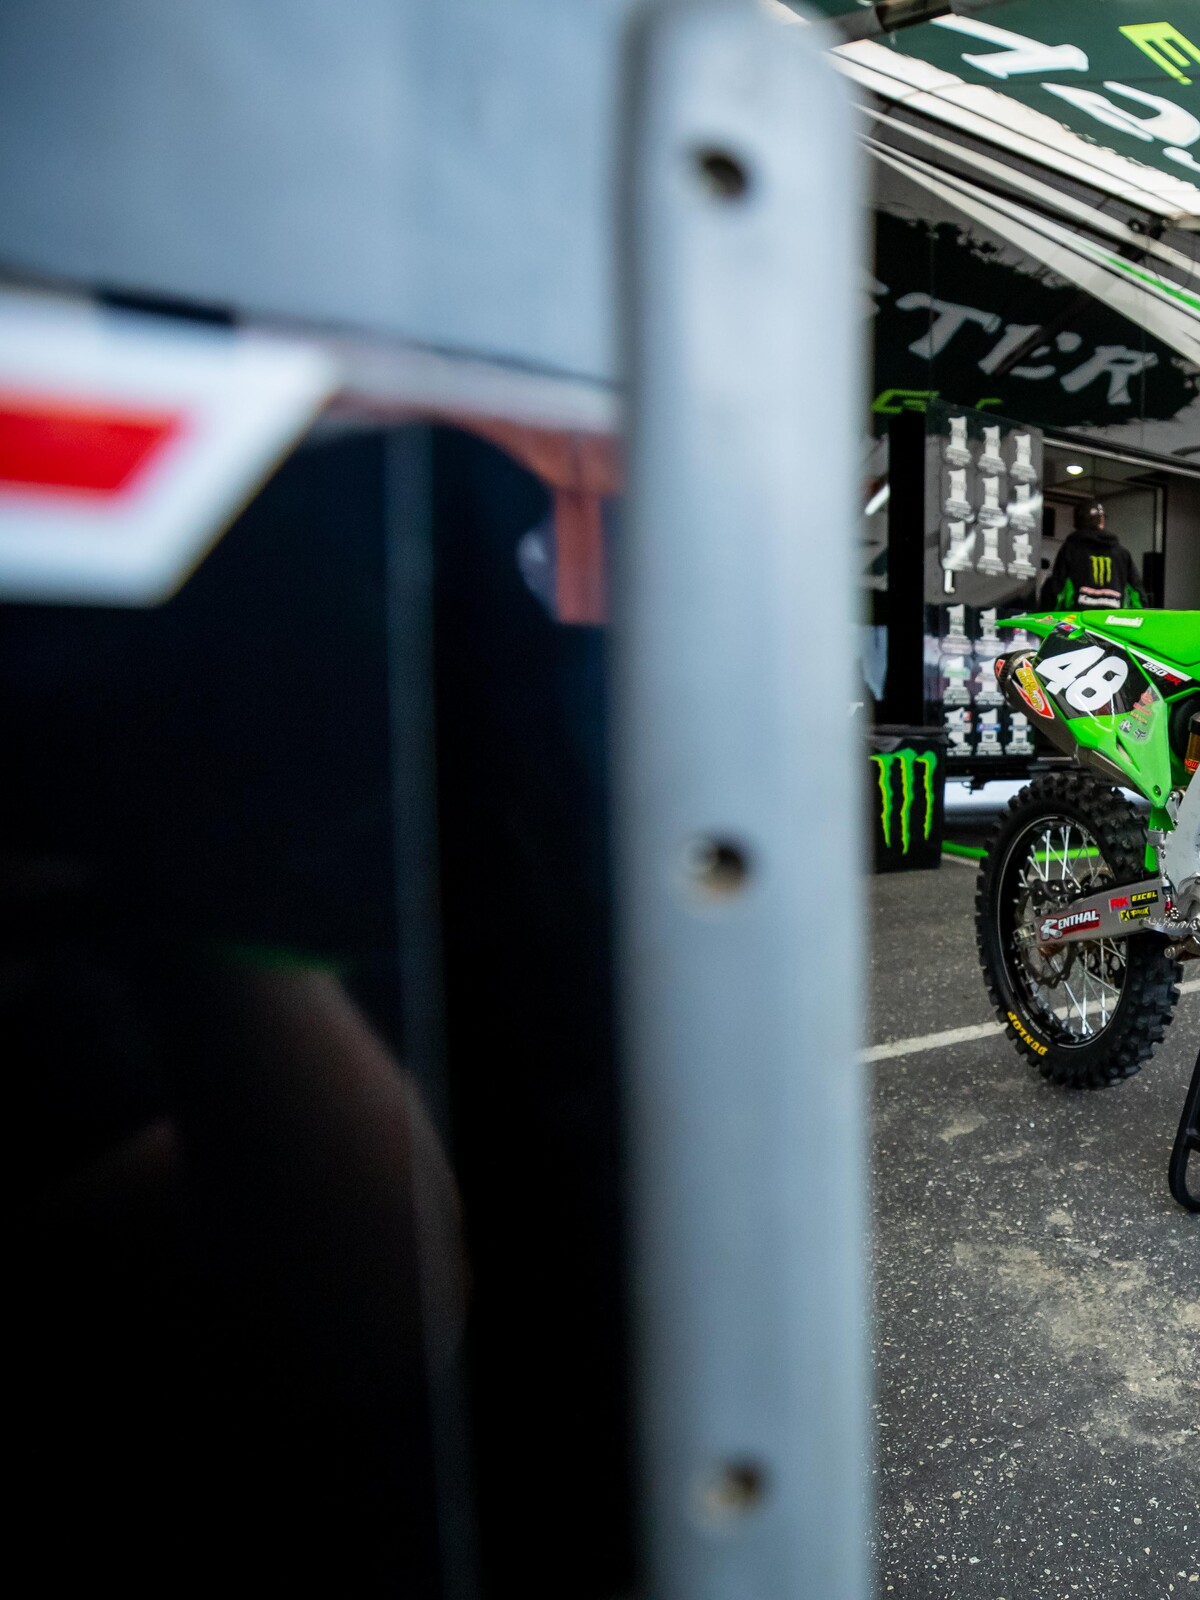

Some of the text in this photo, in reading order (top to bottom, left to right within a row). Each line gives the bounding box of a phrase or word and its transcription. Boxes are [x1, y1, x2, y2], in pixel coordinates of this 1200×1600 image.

[1035, 645, 1128, 712] 48
[1131, 891, 1158, 902] EXCEL
[1007, 1011, 1049, 1056] DUNLOP
